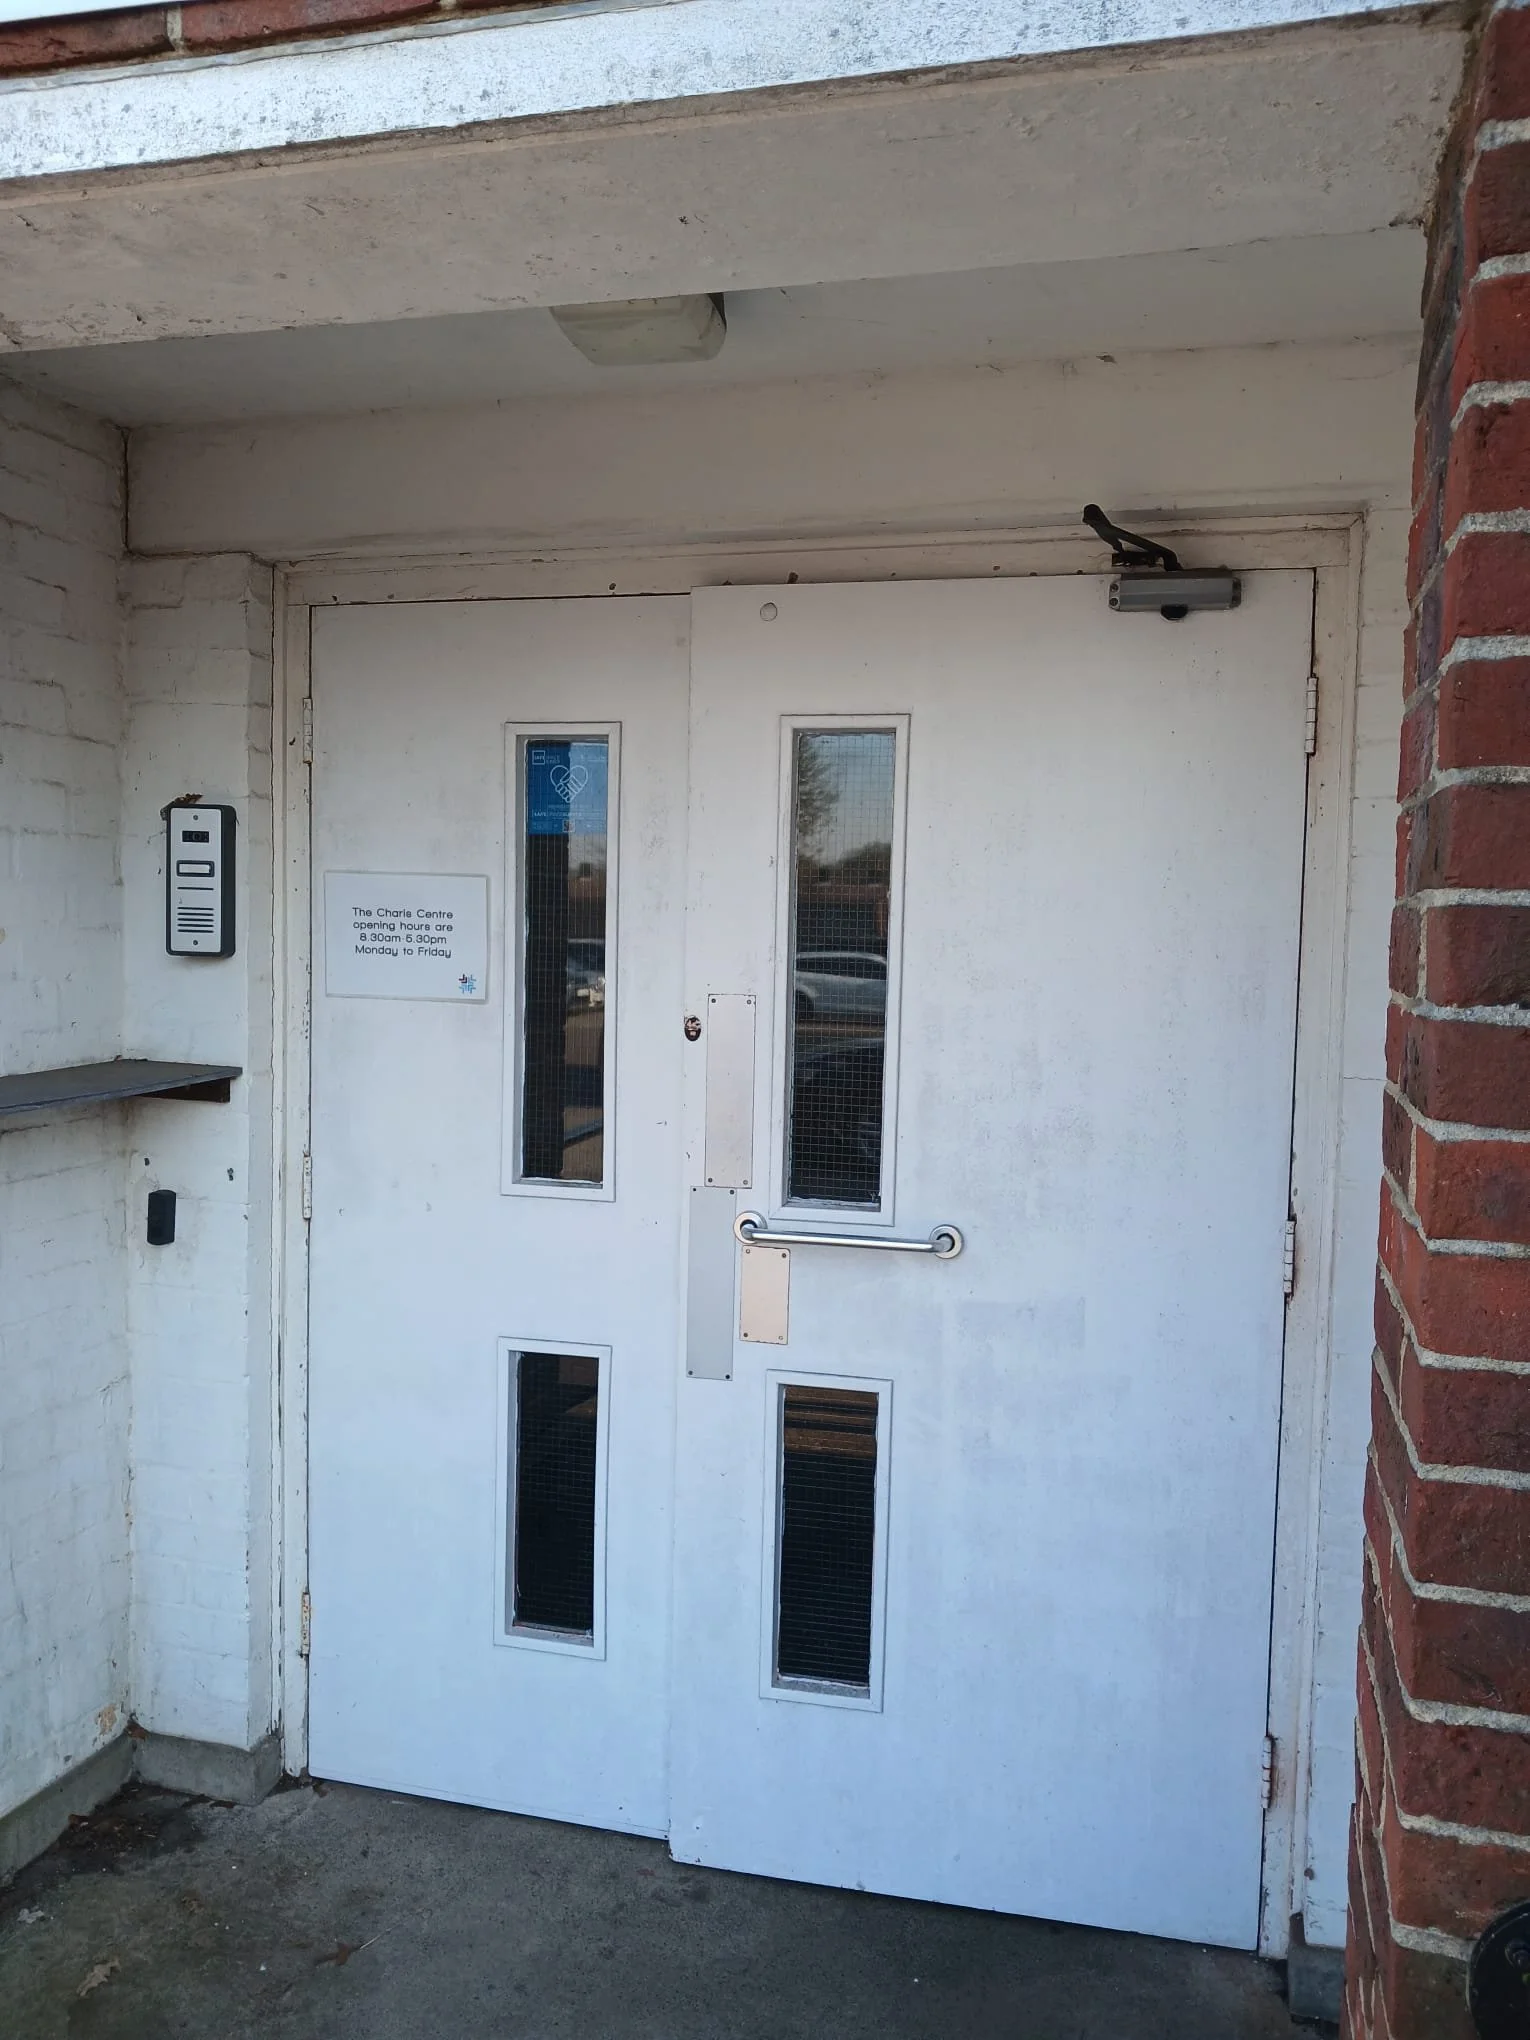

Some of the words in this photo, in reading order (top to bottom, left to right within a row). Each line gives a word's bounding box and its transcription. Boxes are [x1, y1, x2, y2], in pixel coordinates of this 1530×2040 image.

[352, 907, 372, 917] The
[377, 908, 411, 918] Charis
[417, 909, 453, 919] Centre
[353, 921, 395, 931] opening
[400, 922, 430, 931] hours
[435, 924, 453, 932] are
[355, 945, 398, 956] Monday
[403, 947, 413, 956] to
[418, 947, 451, 959] Friday
